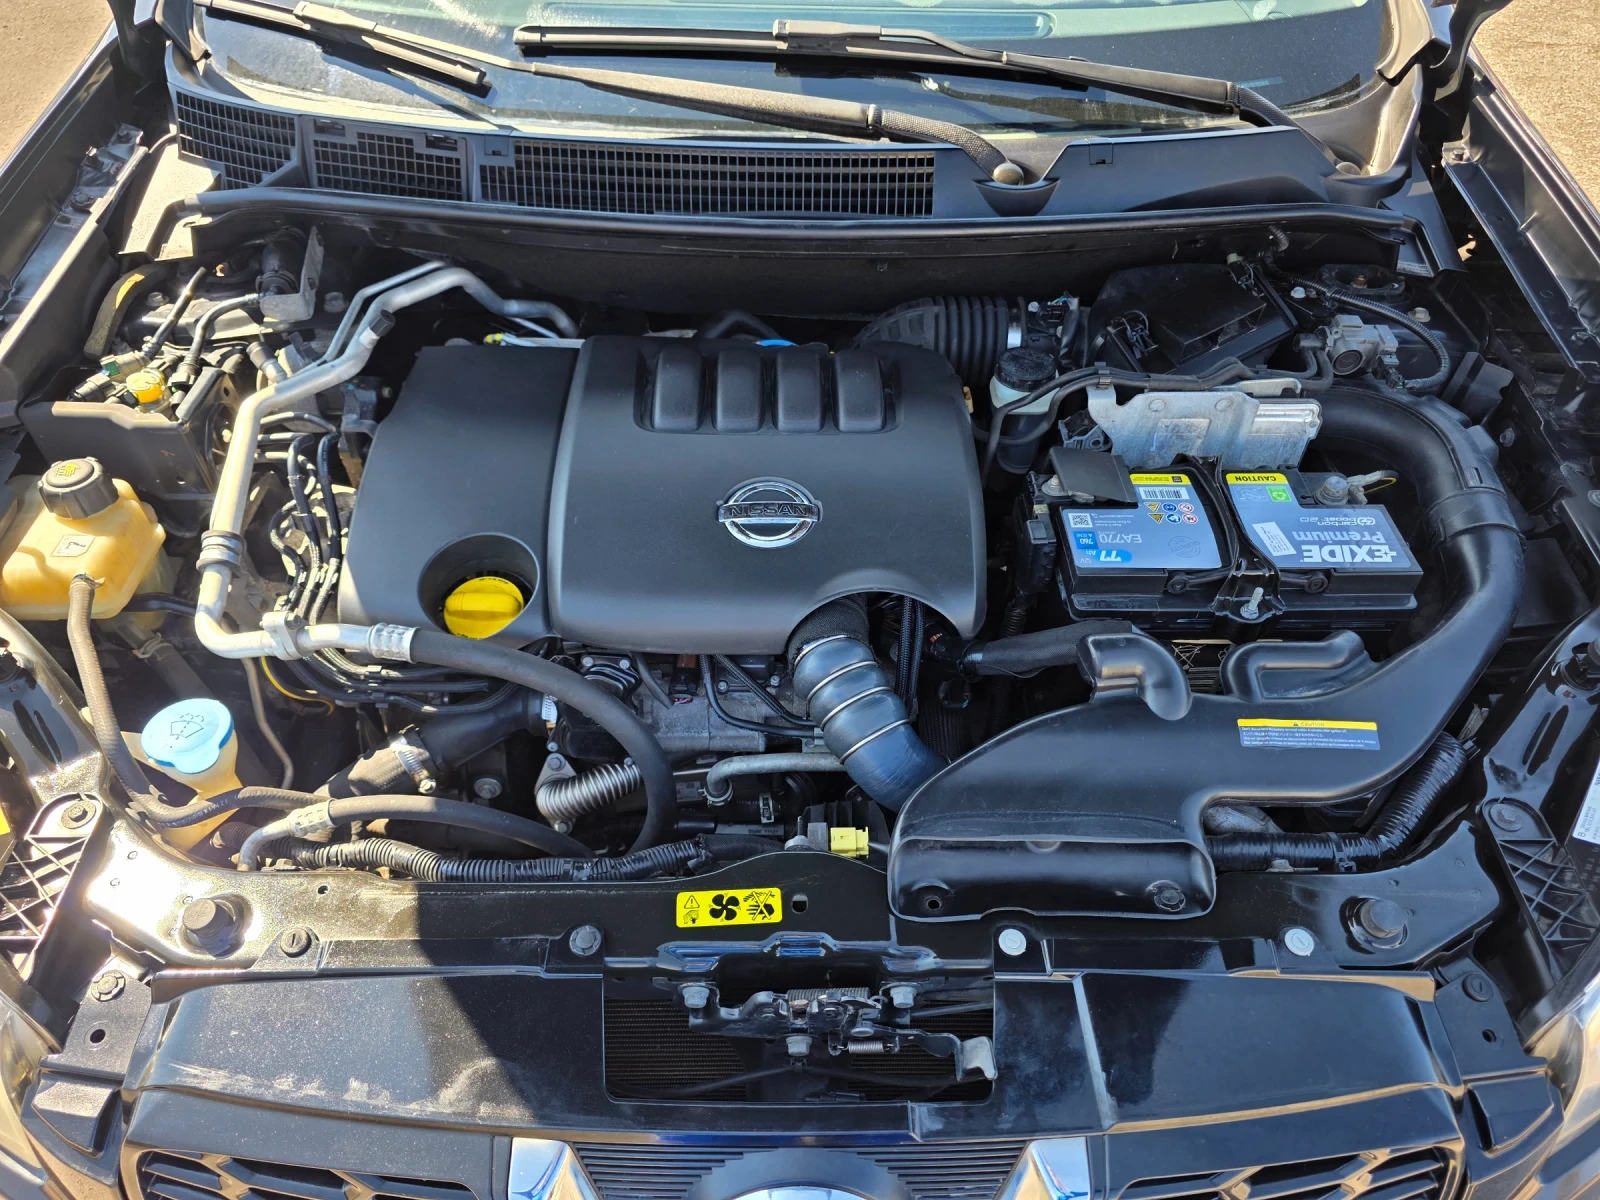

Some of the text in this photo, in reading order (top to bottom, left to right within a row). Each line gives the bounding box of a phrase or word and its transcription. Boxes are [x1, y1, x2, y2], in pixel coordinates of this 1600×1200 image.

[1235, 475, 1276, 483] CAUTION
[728, 504, 808, 517] NISSAN
[1079, 538, 1094, 546] 760
[1098, 533, 1142, 544] EA770
[1292, 531, 1386, 543] Premium
[1099, 550, 1122, 562] 77
[1303, 545, 1397, 562] EXIDE
